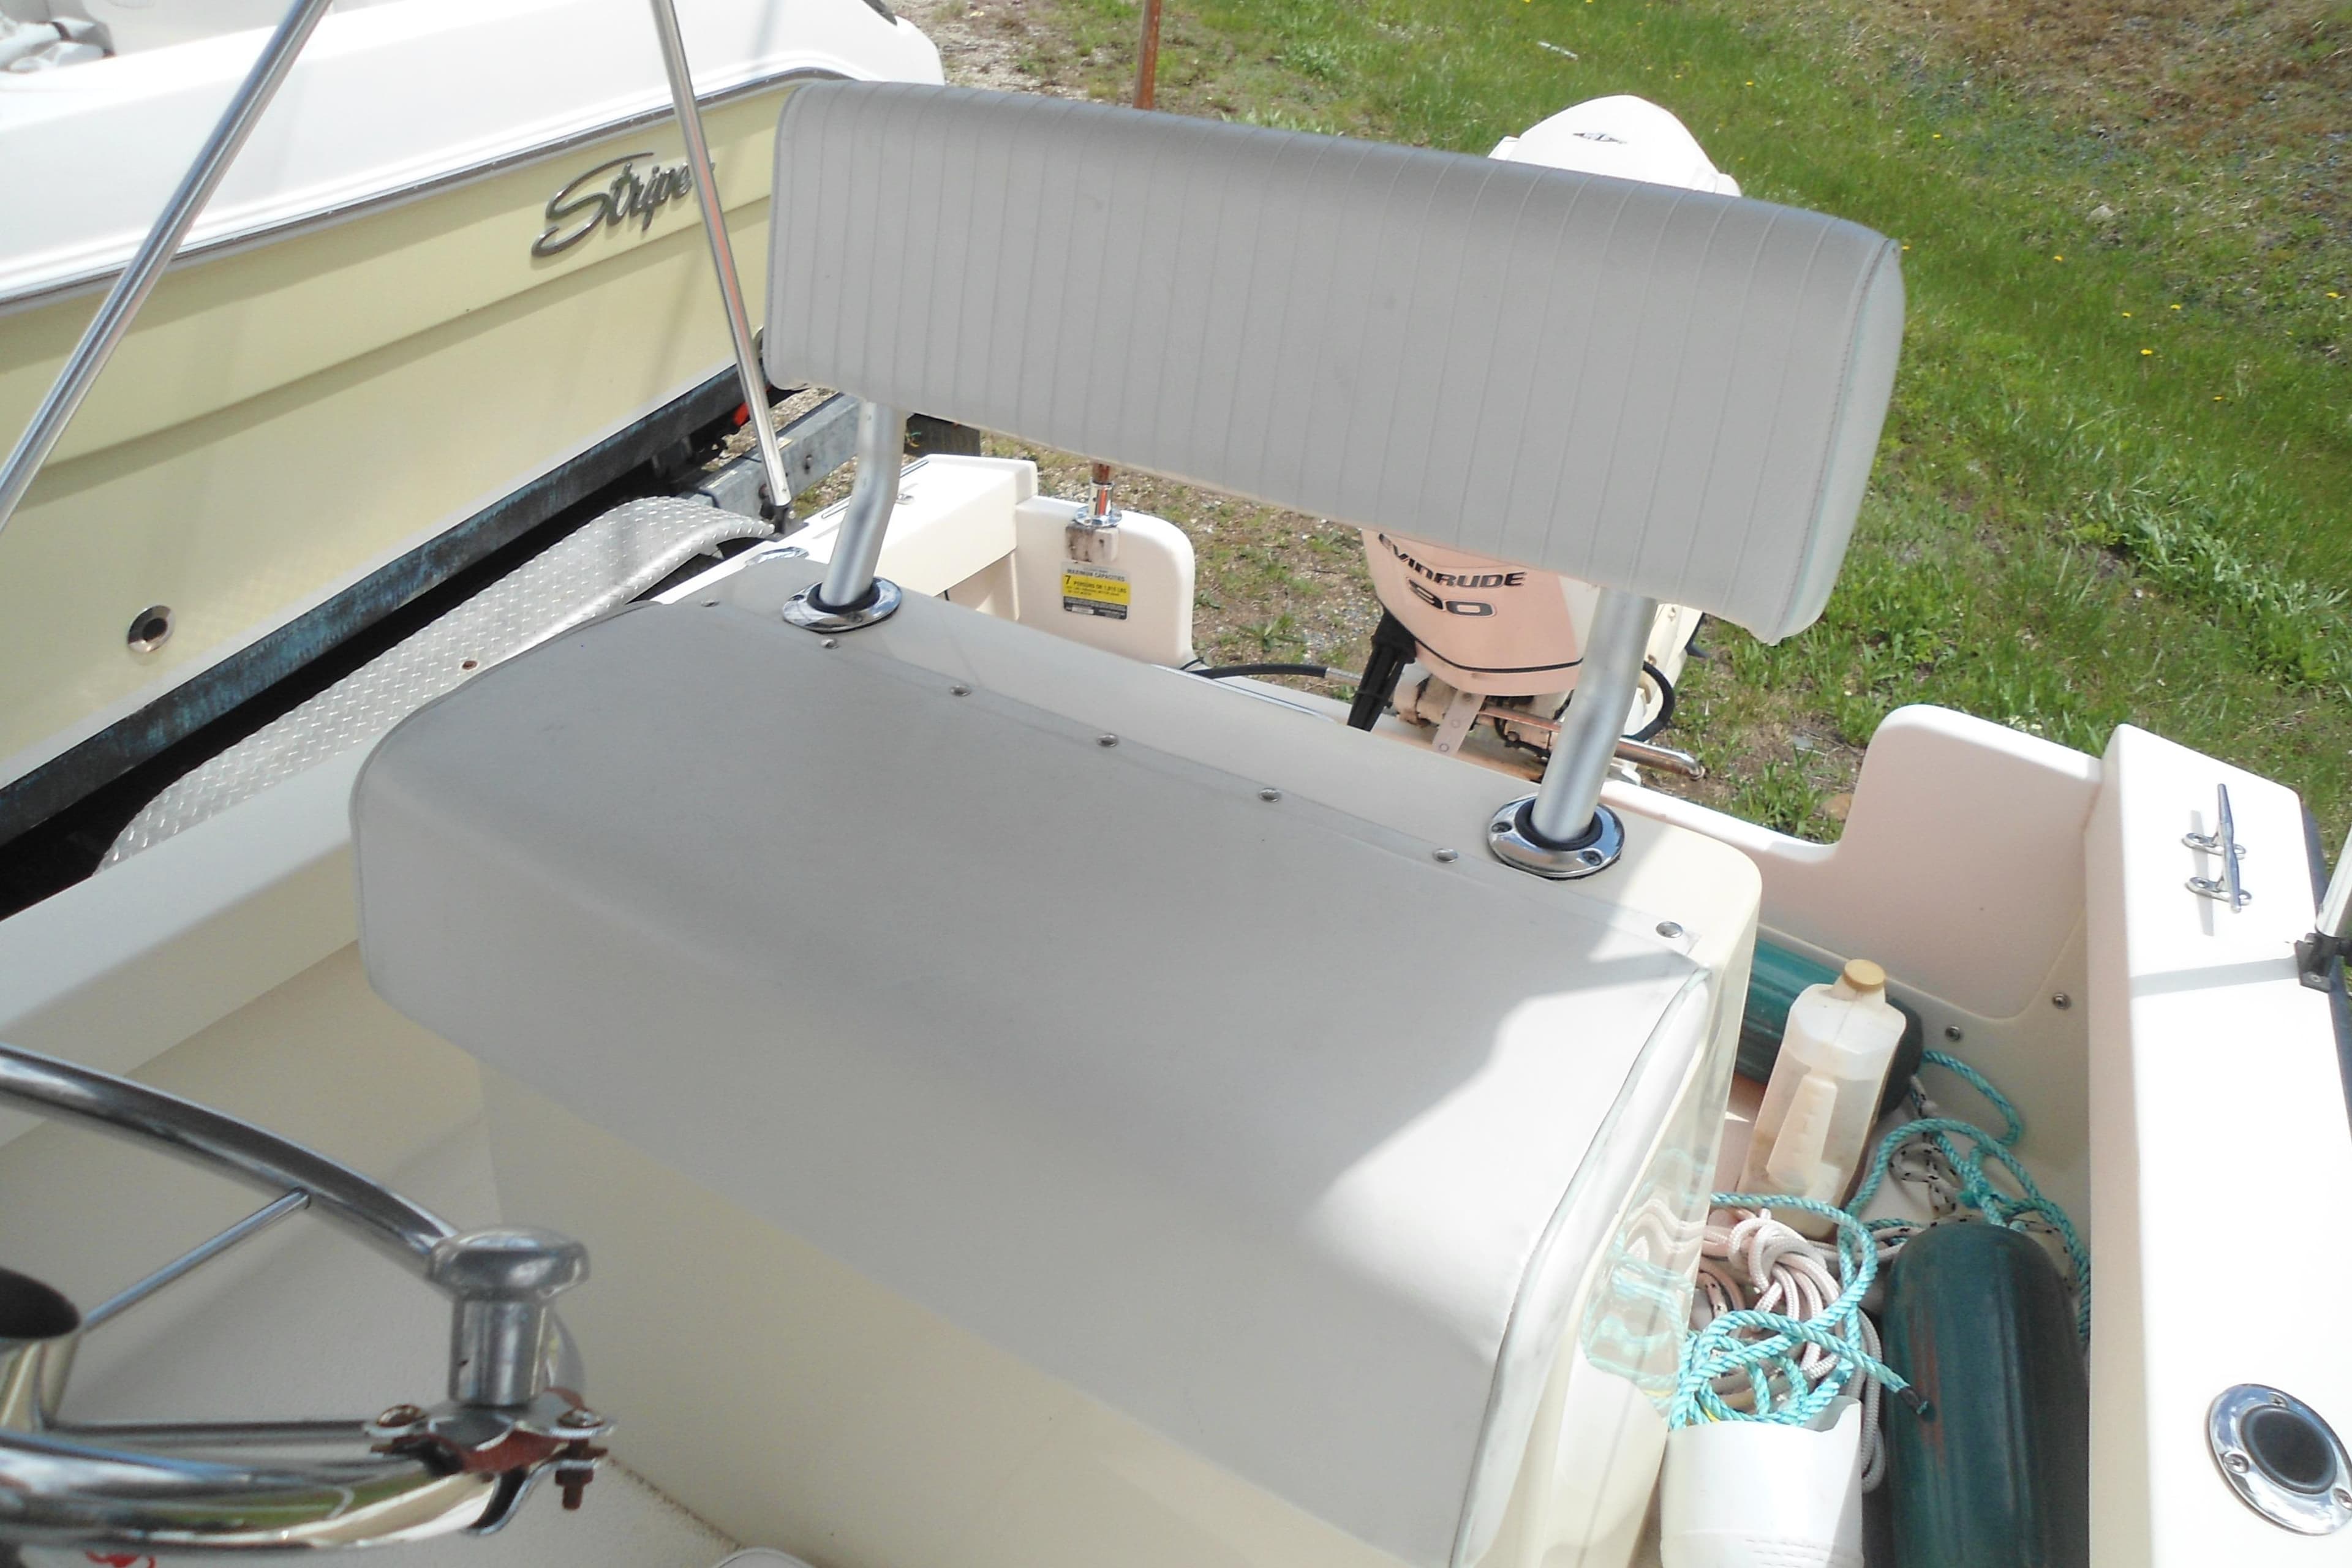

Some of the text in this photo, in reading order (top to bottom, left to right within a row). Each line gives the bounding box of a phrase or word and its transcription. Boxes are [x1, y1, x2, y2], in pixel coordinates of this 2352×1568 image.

[531, 151, 715, 257] Stripe
[1065, 575, 1071, 584] 7
[1068, 568, 1093, 577] MAXIMUM
[1095, 573, 1125, 582] CAPACITIES
[1378, 533, 1527, 588] EVINRUDE
[1408, 578, 1495, 617] 90
